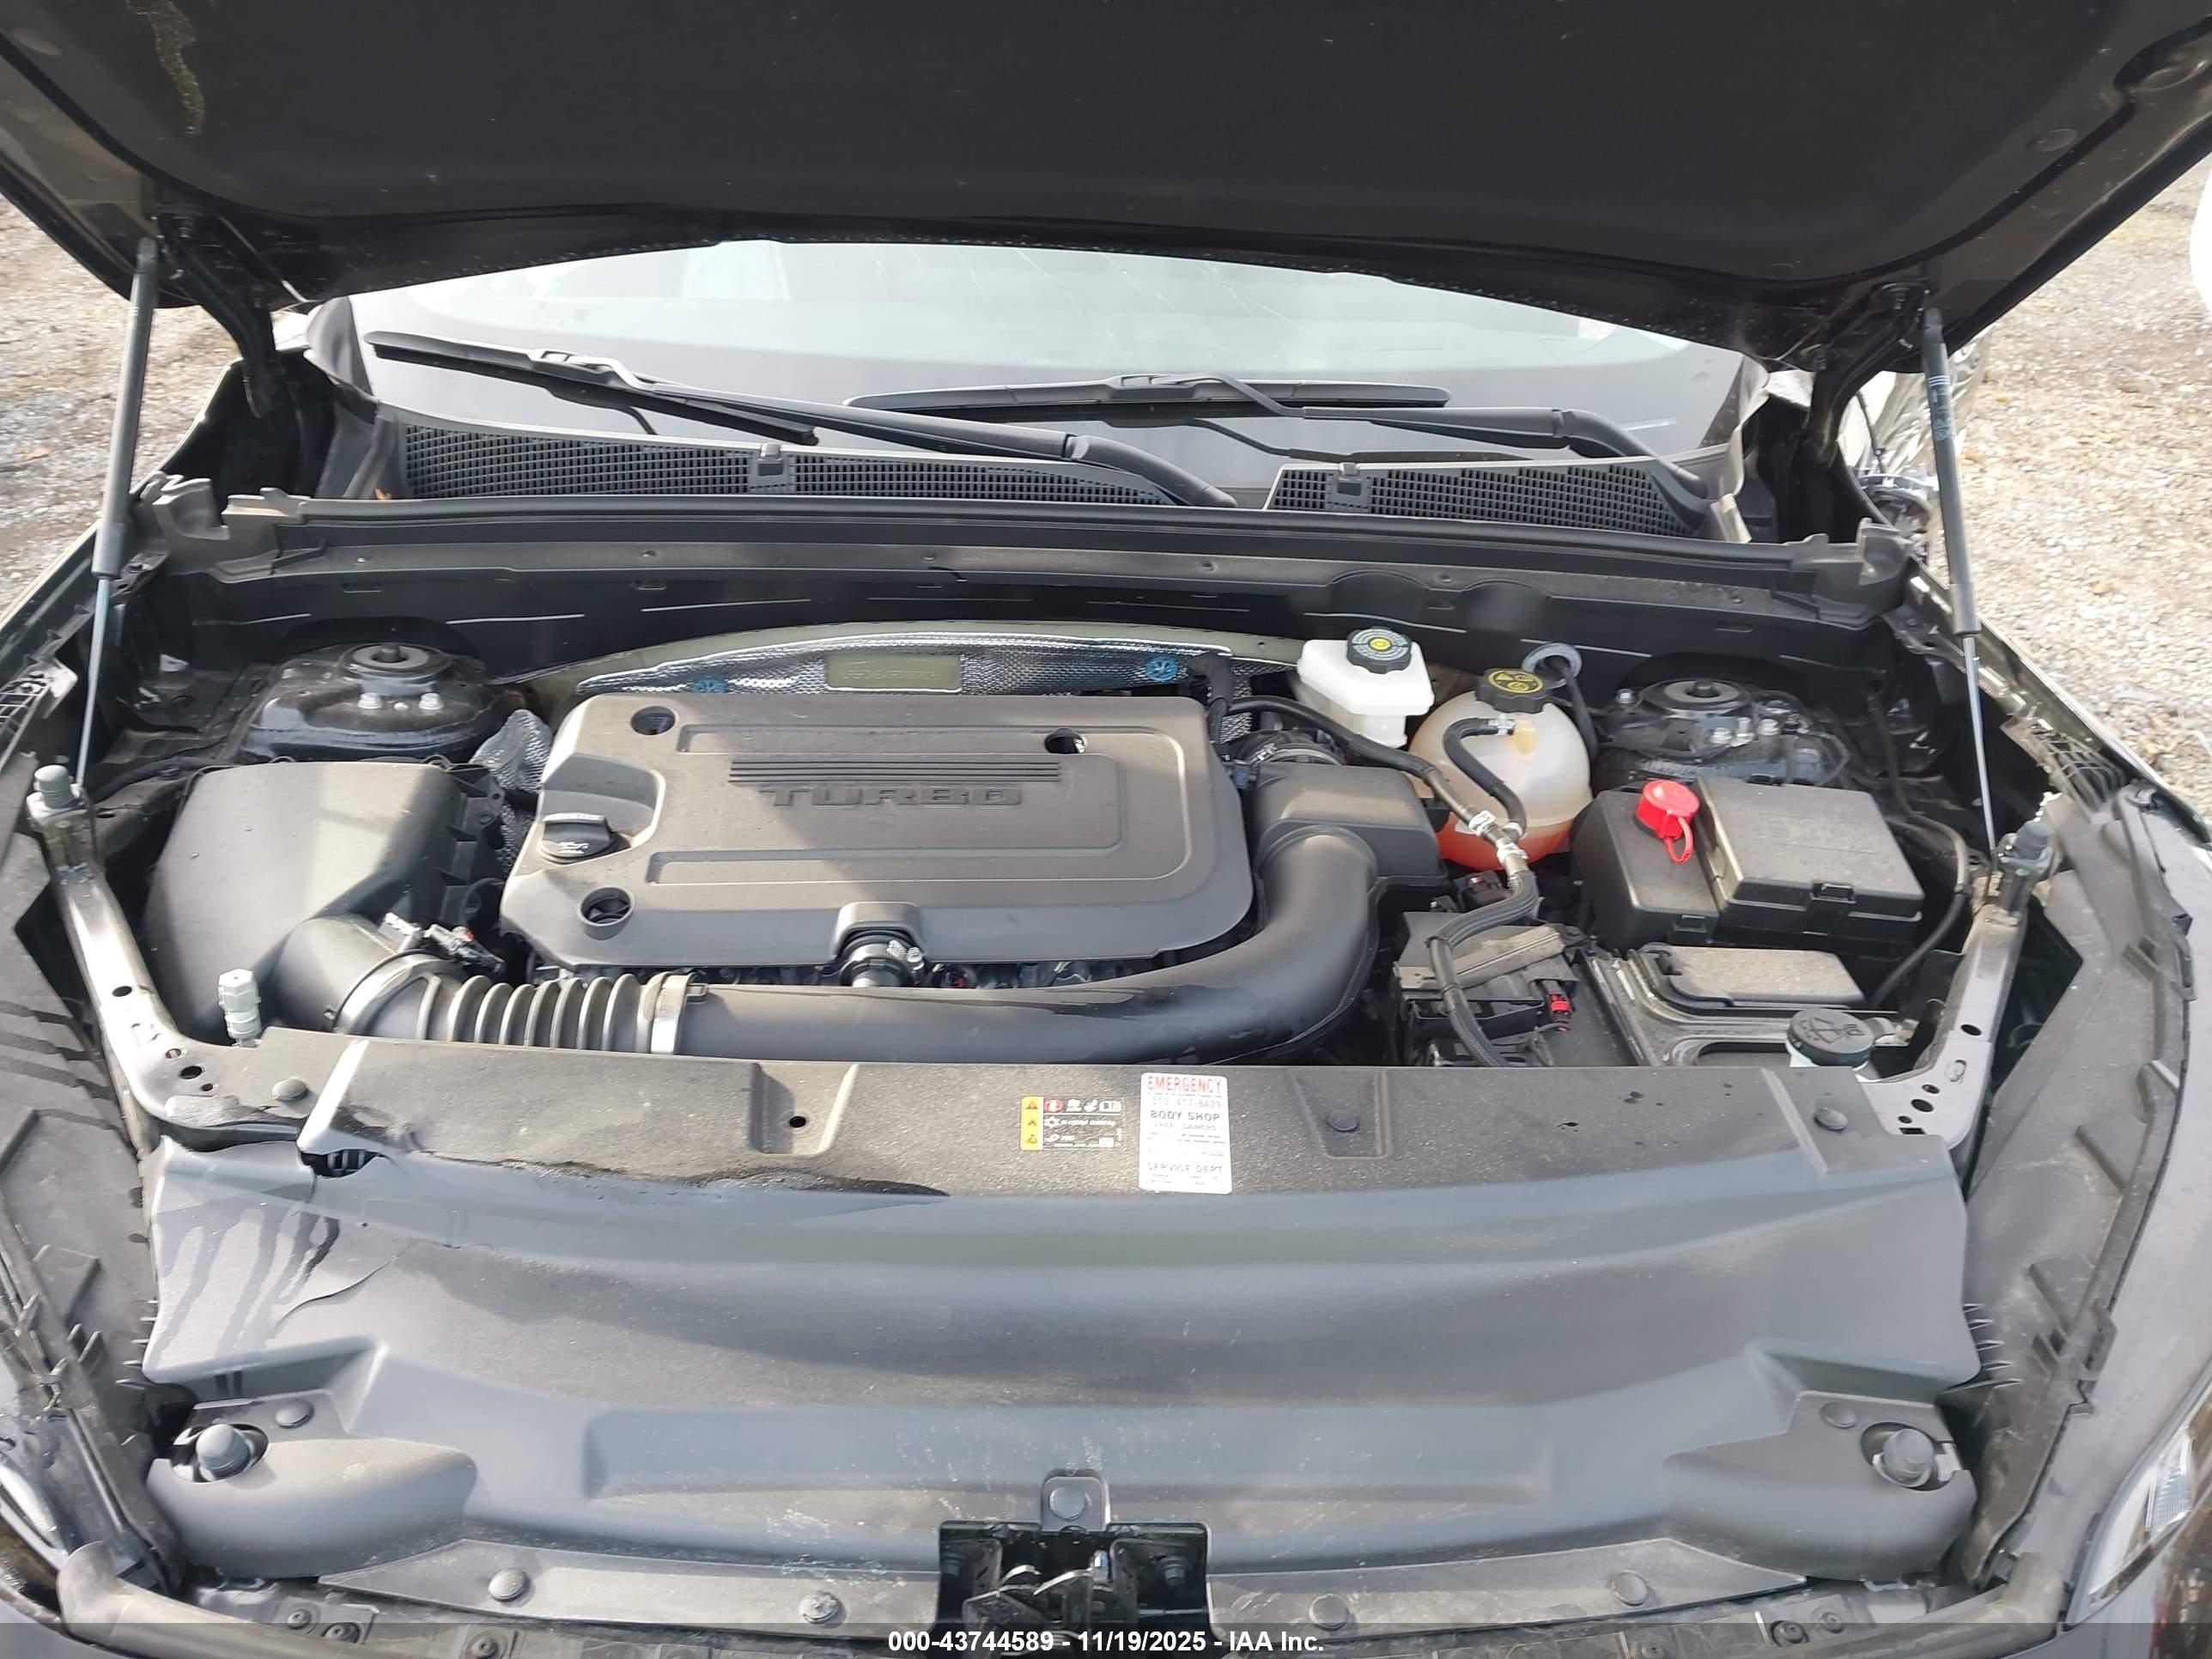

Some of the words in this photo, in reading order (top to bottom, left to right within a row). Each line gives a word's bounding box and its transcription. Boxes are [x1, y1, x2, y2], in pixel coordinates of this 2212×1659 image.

[759, 785, 1022, 806] TURBO
[1148, 1076, 1222, 1093] EMERGENCY
[1151, 1109, 1182, 1120] BODY
[1188, 1112, 1219, 1121] SHOP
[1196, 1164, 1222, 1174] DEPT
